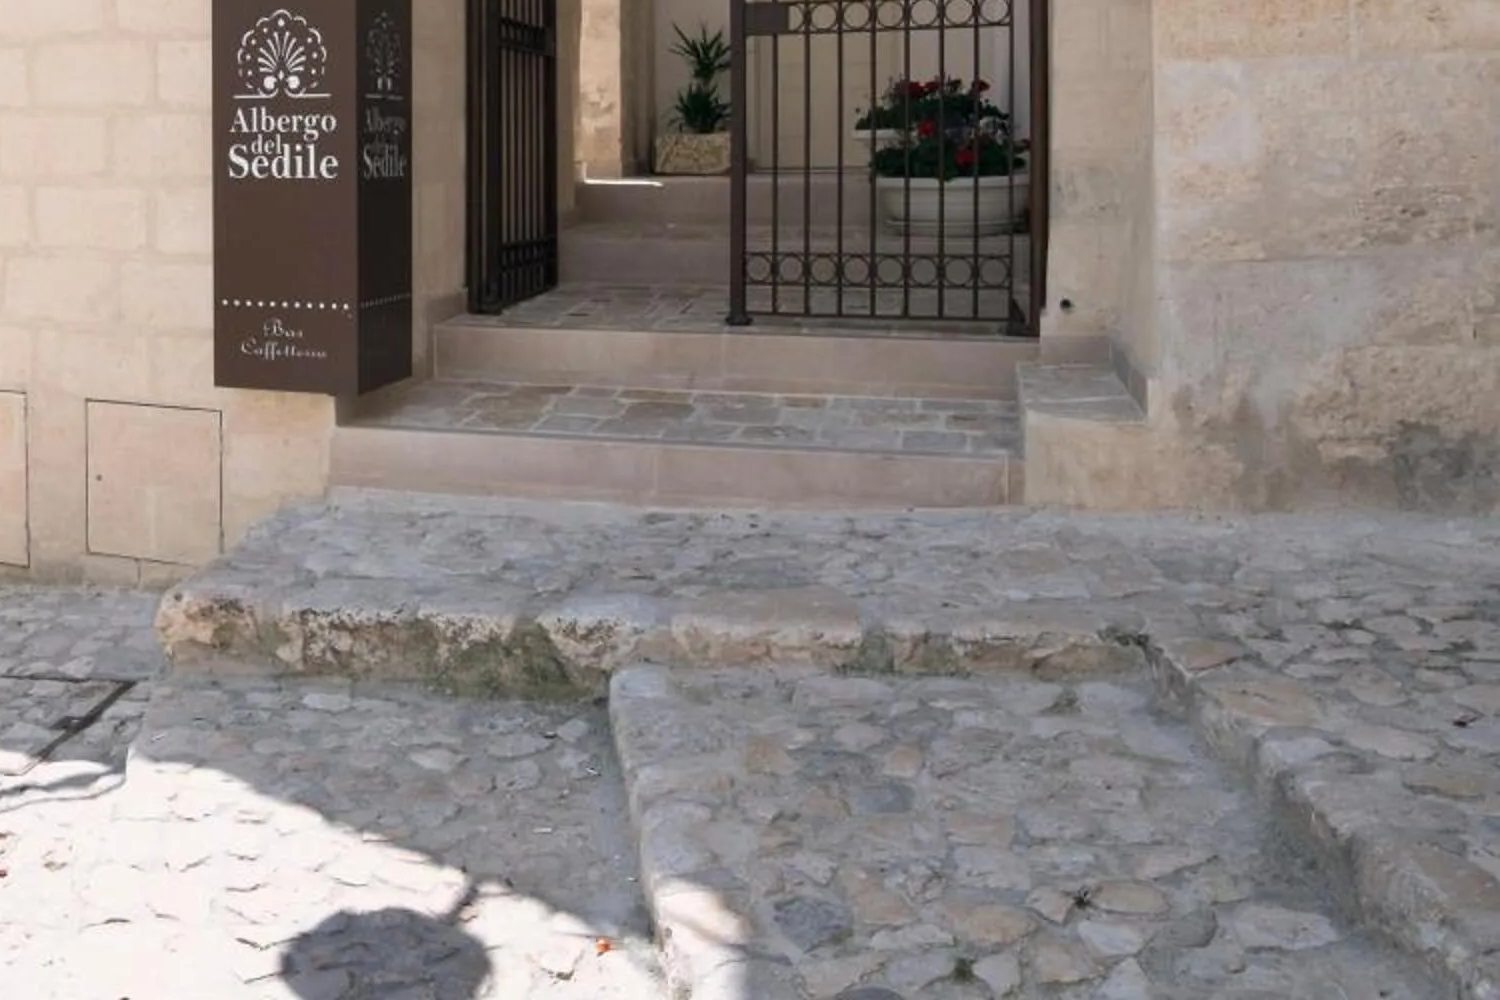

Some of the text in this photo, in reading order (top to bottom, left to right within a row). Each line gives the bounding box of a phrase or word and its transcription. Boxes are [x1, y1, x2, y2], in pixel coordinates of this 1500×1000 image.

[229, 106, 338, 141] Albergo
[228, 143, 339, 179] Sedile
[251, 133, 282, 155] del
